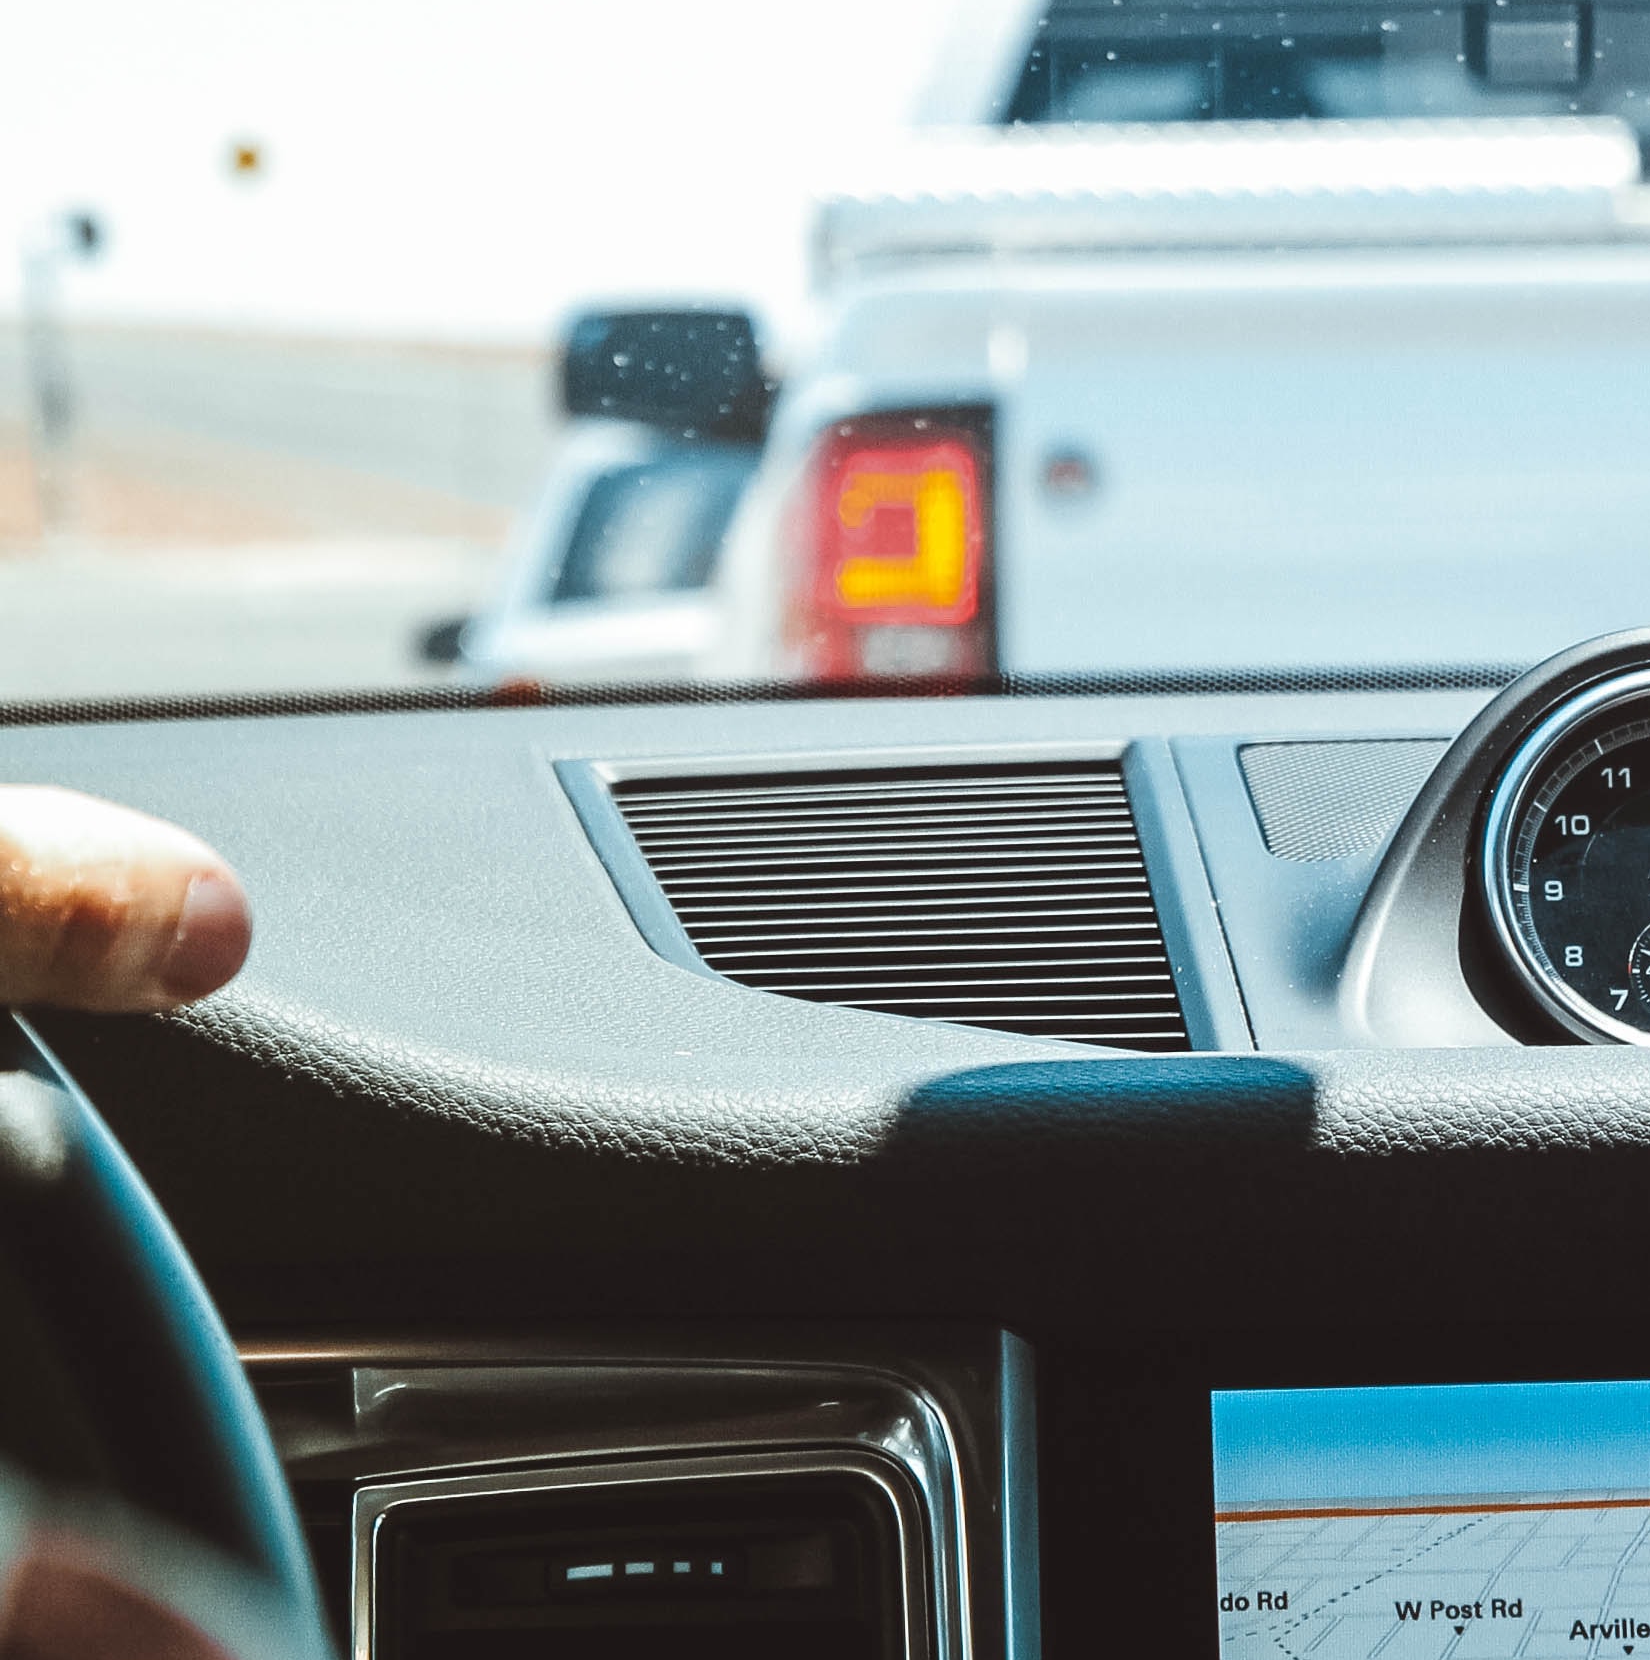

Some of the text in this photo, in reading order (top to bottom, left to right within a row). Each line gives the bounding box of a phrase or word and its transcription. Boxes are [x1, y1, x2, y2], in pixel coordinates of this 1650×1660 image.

[1602, 768, 1631, 787] 11
[1555, 816, 1589, 835] 10
[1545, 882, 1563, 900] 9
[1565, 947, 1583, 967] 8
[1610, 990, 1628, 1011] 7
[1258, 1591, 1288, 1611] Rd
[1396, 1599, 1522, 1621] W Post Rd
[1570, 1618, 1650, 1641] Arville
